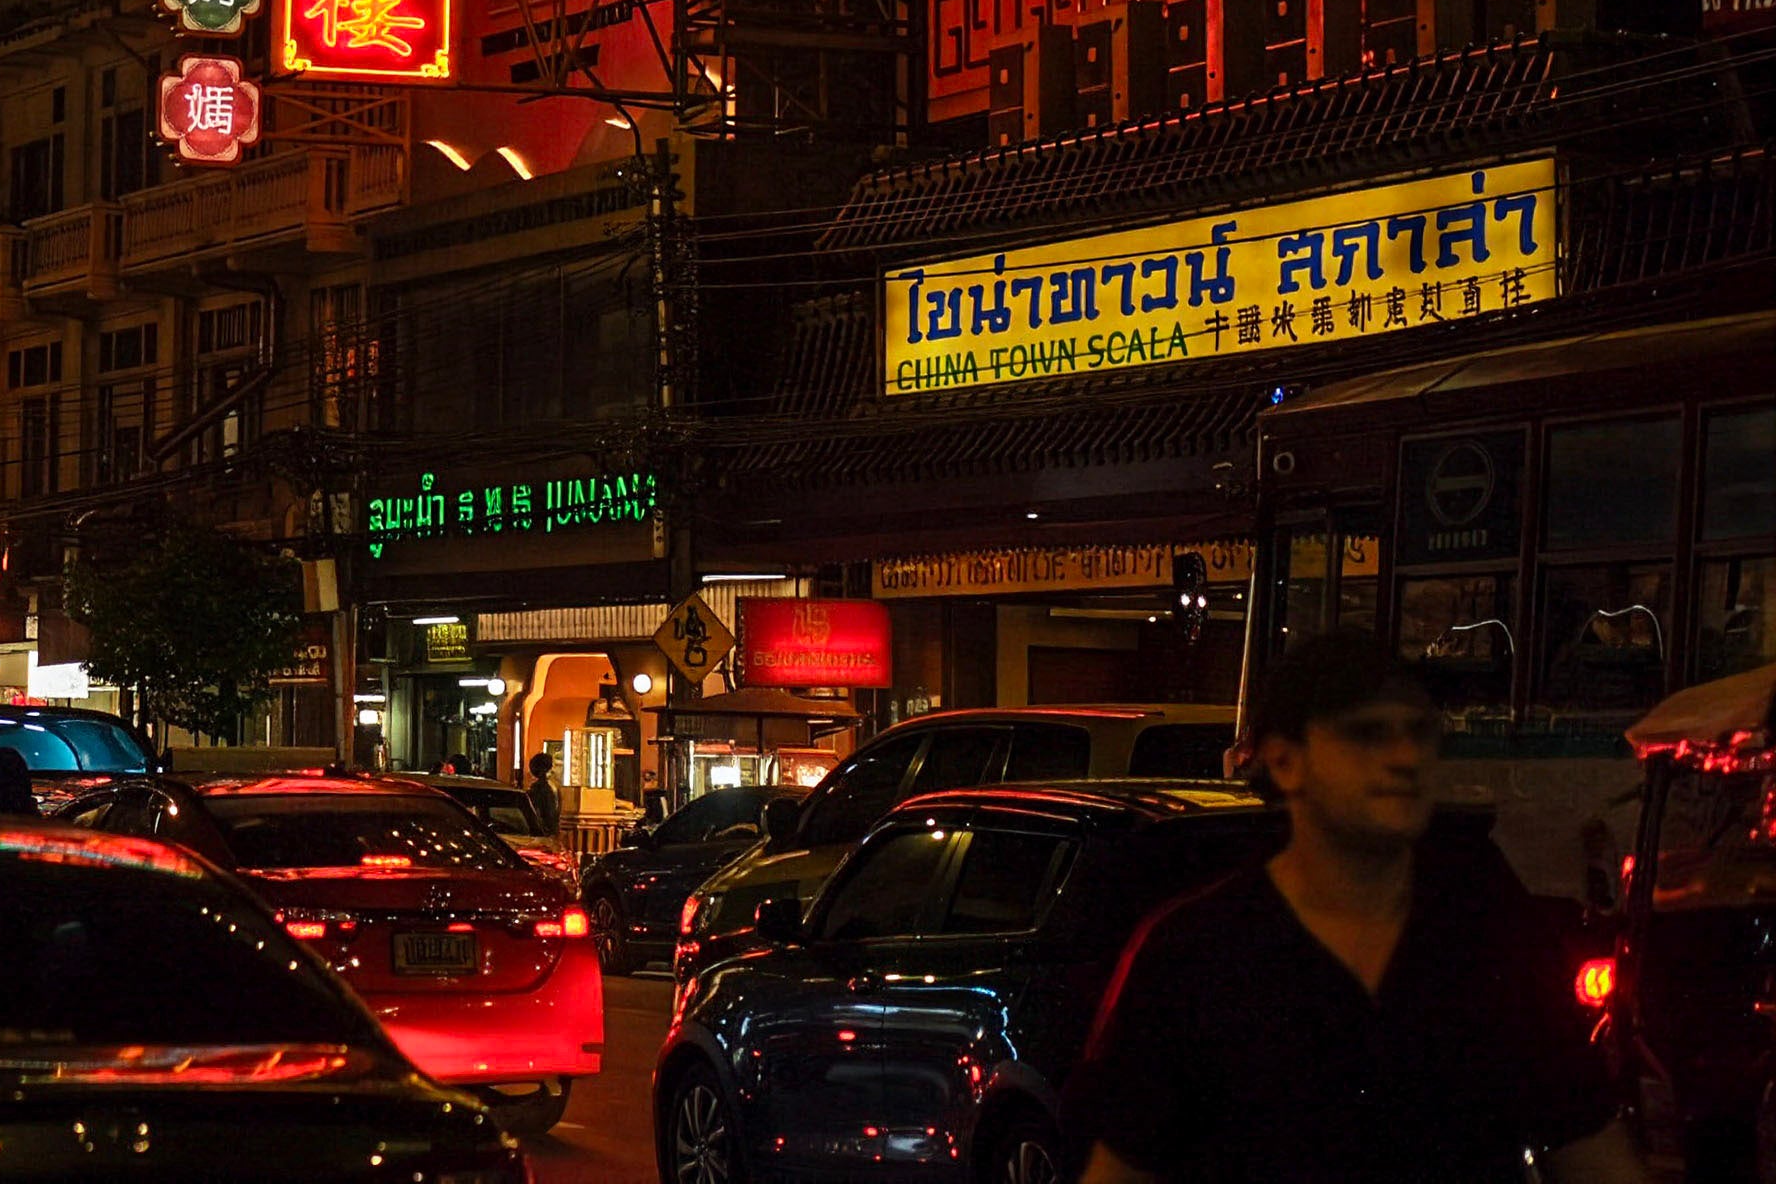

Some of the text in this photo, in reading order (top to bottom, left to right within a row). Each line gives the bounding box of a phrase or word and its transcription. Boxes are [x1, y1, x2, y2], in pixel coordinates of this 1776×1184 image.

[900, 171, 1538, 345] ไชน่าทาวน์ สกาล่า
[896, 322, 1189, 391] CHINA TOWN SCALA
